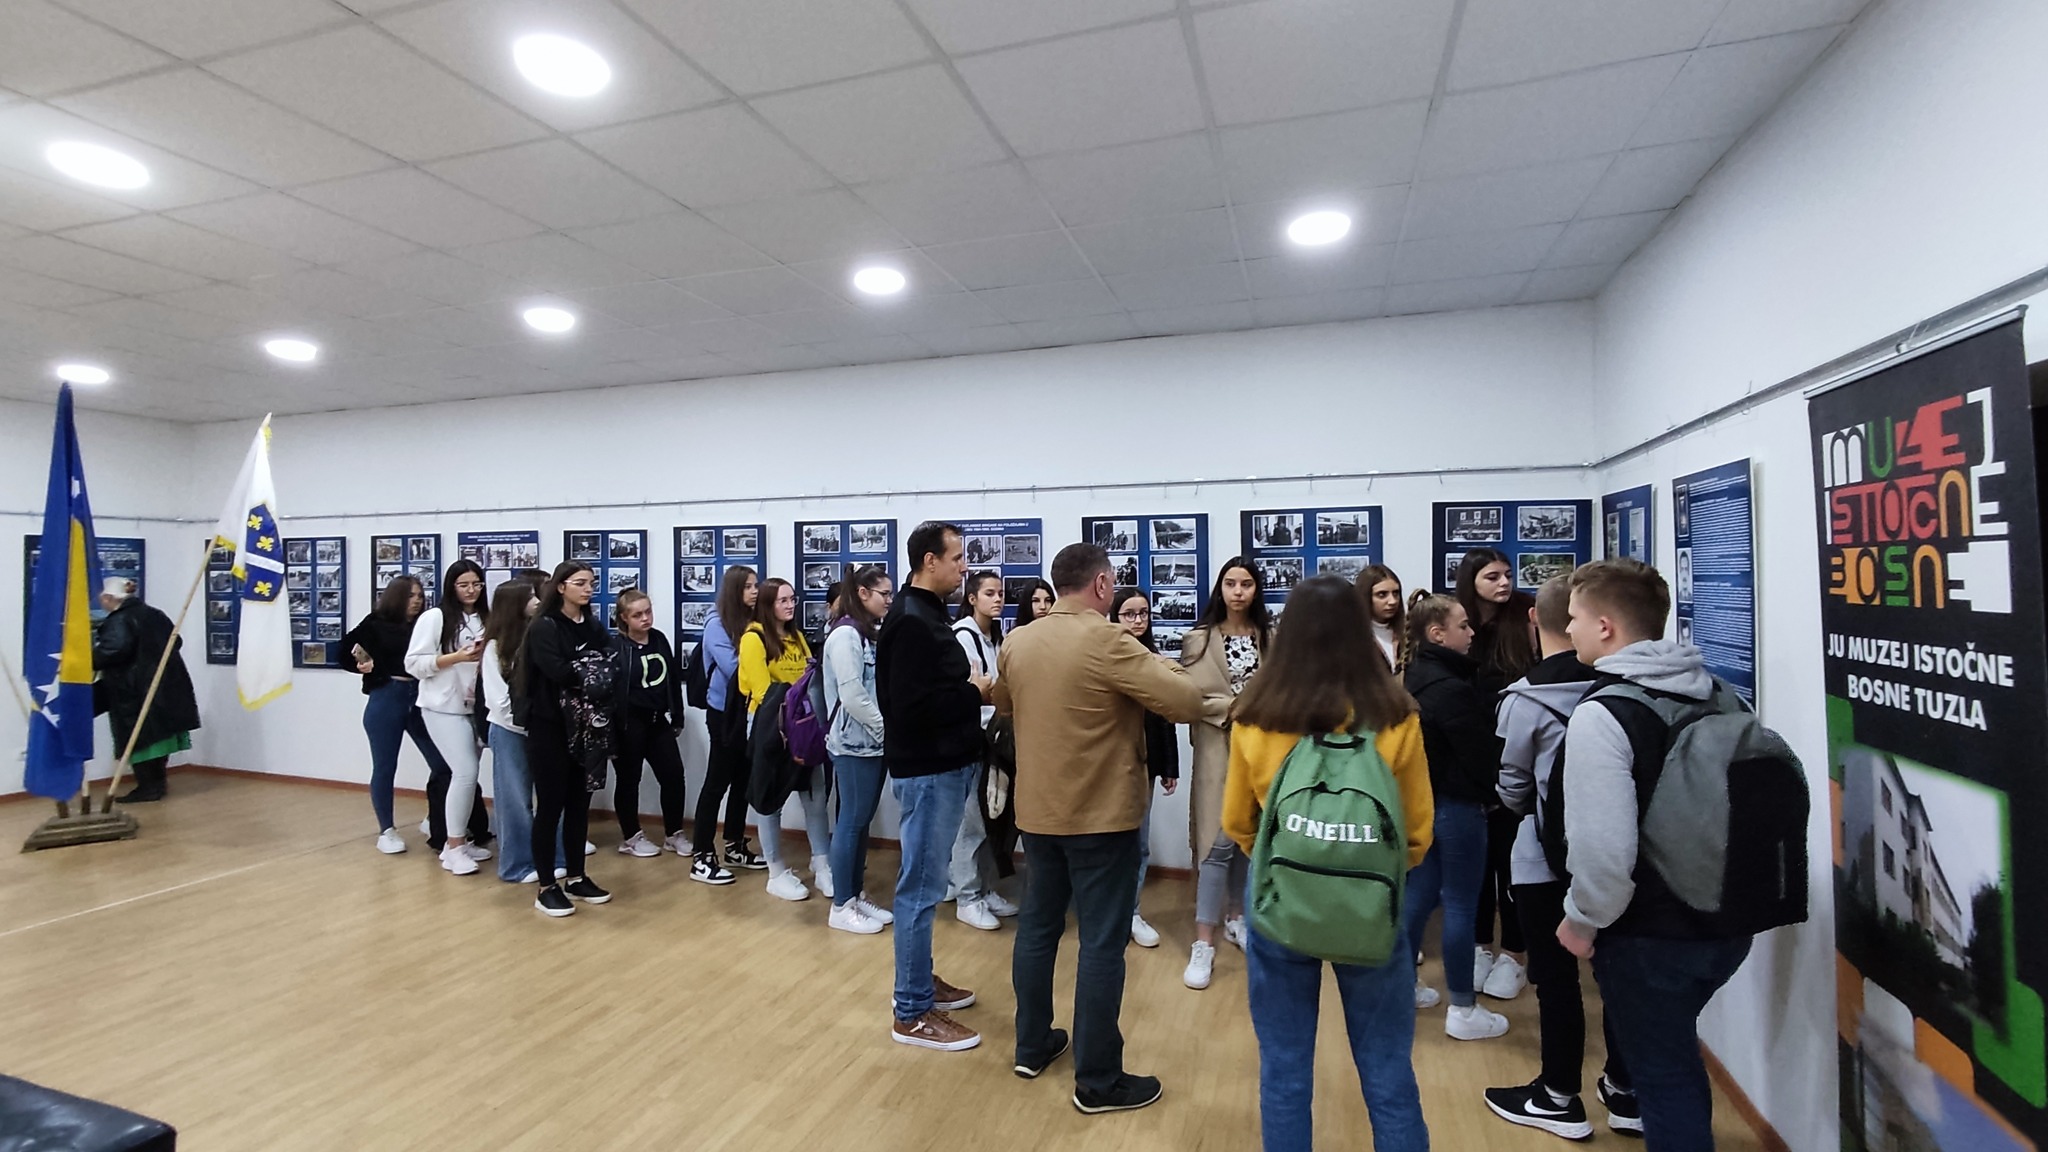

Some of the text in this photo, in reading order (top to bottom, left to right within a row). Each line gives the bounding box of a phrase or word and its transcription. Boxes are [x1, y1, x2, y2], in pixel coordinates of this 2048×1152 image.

[1828, 633, 2015, 687] JU MUZEJ ISTOČNE
[1847, 674, 1988, 731] BOSNE TUZLA
[1286, 813, 1378, 843] O'NEILL
